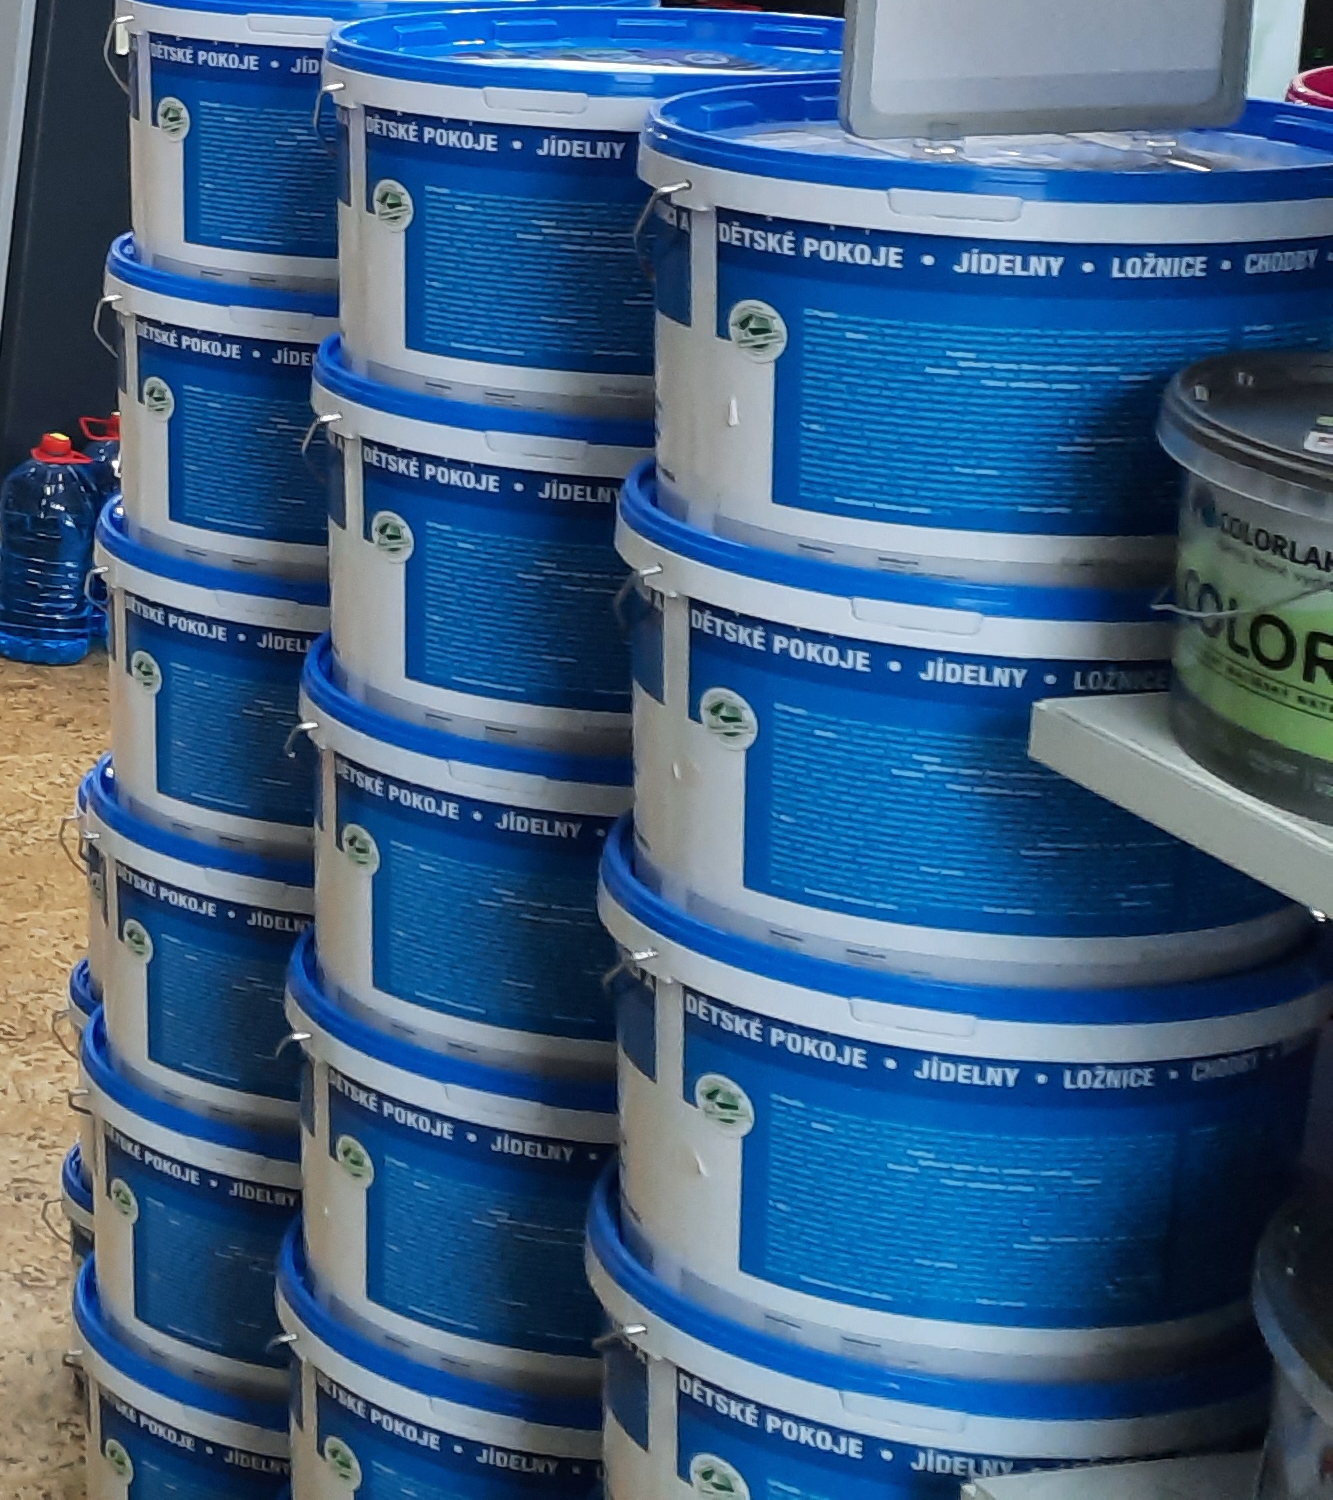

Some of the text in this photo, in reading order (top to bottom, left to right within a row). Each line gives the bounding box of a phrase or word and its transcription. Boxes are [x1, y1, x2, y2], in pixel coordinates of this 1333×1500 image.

[197, 51, 260, 73] POKOJE
[365, 113, 627, 161] DĚTSKÉ POKOJE JÍDELNY
[718, 221, 1319, 278] DĚTSKÉ POKOJE JÍDELNY LOŽNICE CHODBY
[180, 334, 242, 361] POKOJE
[363, 445, 420, 479] DĚTSKÉ
[424, 464, 500, 493] POKOJE
[168, 614, 228, 643] POKOJE
[691, 608, 767, 652] DĚTSKÉ
[773, 635, 871, 673] POKOJE
[919, 657, 1028, 690] JÍDELNY
[388, 786, 460, 819] POKOJE
[494, 810, 582, 840] JÍDELNY
[159, 884, 217, 918] POKOJE
[685, 993, 764, 1041] DĚTSKÉ
[770, 1026, 868, 1071] POKOJE
[915, 1059, 1020, 1089] JÍDELNY
[1063, 1063, 1155, 1090] LOŽNICE
[383, 1102, 455, 1141] POKOJE
[490, 1133, 574, 1163] JÍDELNY
[144, 1155, 201, 1188] POKOJE
[371, 1408, 442, 1453] POKOJE
[476, 1446, 560, 1476] JÍDELNY
[678, 1374, 759, 1430] DĚTSKÉ
[766, 1414, 864, 1459] POKOJE
